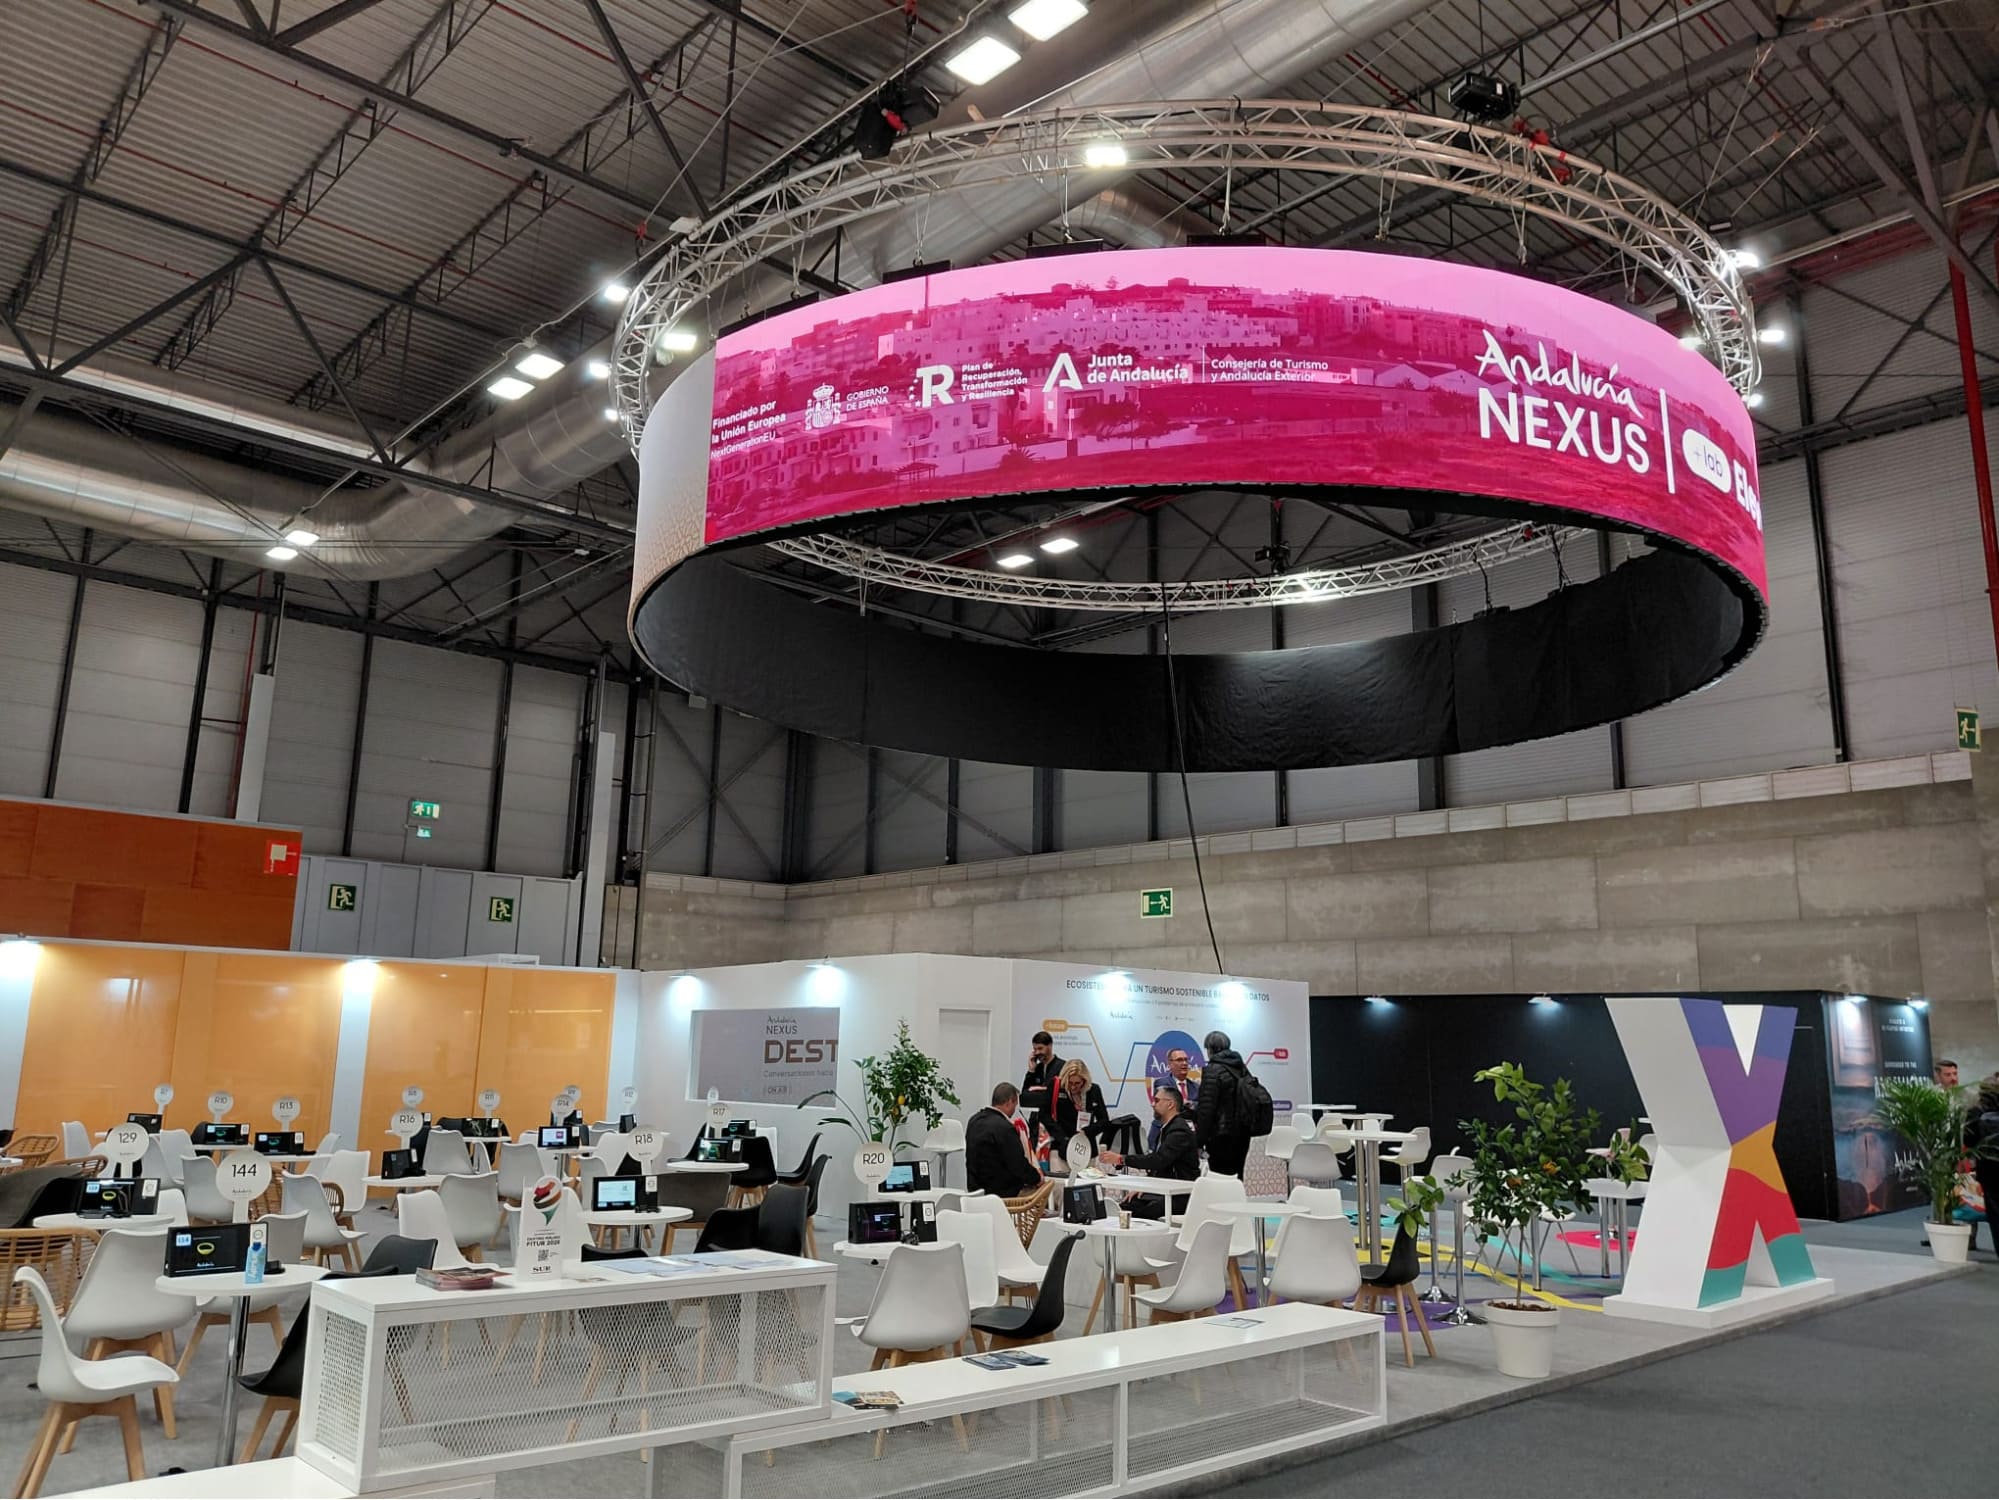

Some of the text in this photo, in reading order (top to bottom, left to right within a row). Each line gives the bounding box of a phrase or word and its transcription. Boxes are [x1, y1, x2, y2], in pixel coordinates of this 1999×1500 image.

[962, 362, 994, 372] Plan de
[1088, 353, 1133, 368] Junta
[1211, 358, 1329, 371] Consejería de Turismo
[962, 368, 1023, 381] Recuperación,
[1087, 364, 1189, 383] de Andalucía
[1211, 370, 1315, 382] y Andalucía Exterior
[1474, 329, 1645, 420] Andalucía
[962, 376, 1028, 391] Transformación
[846, 386, 889, 401] GOBIERNO
[962, 388, 1015, 402] y Resiliencia
[846, 396, 889, 412] DE ESPAÑA
[712, 401, 776, 429] Financiado por
[712, 413, 787, 444] la Unión Europea
[1479, 387, 1650, 474] NEXUS
[1145, 985, 1174, 995] TURISMO
[1176, 988, 1212, 998] SOSTENIBLE
[766, 1025, 798, 1035] NEXUS
[764, 1039, 838, 1064] DEST
[400, 1115, 416, 1124] R16
[119, 1132, 137, 1144] 129
[635, 1133, 654, 1145] R18
[863, 1152, 885, 1165] R20
[231, 1163, 258, 1178] 144
